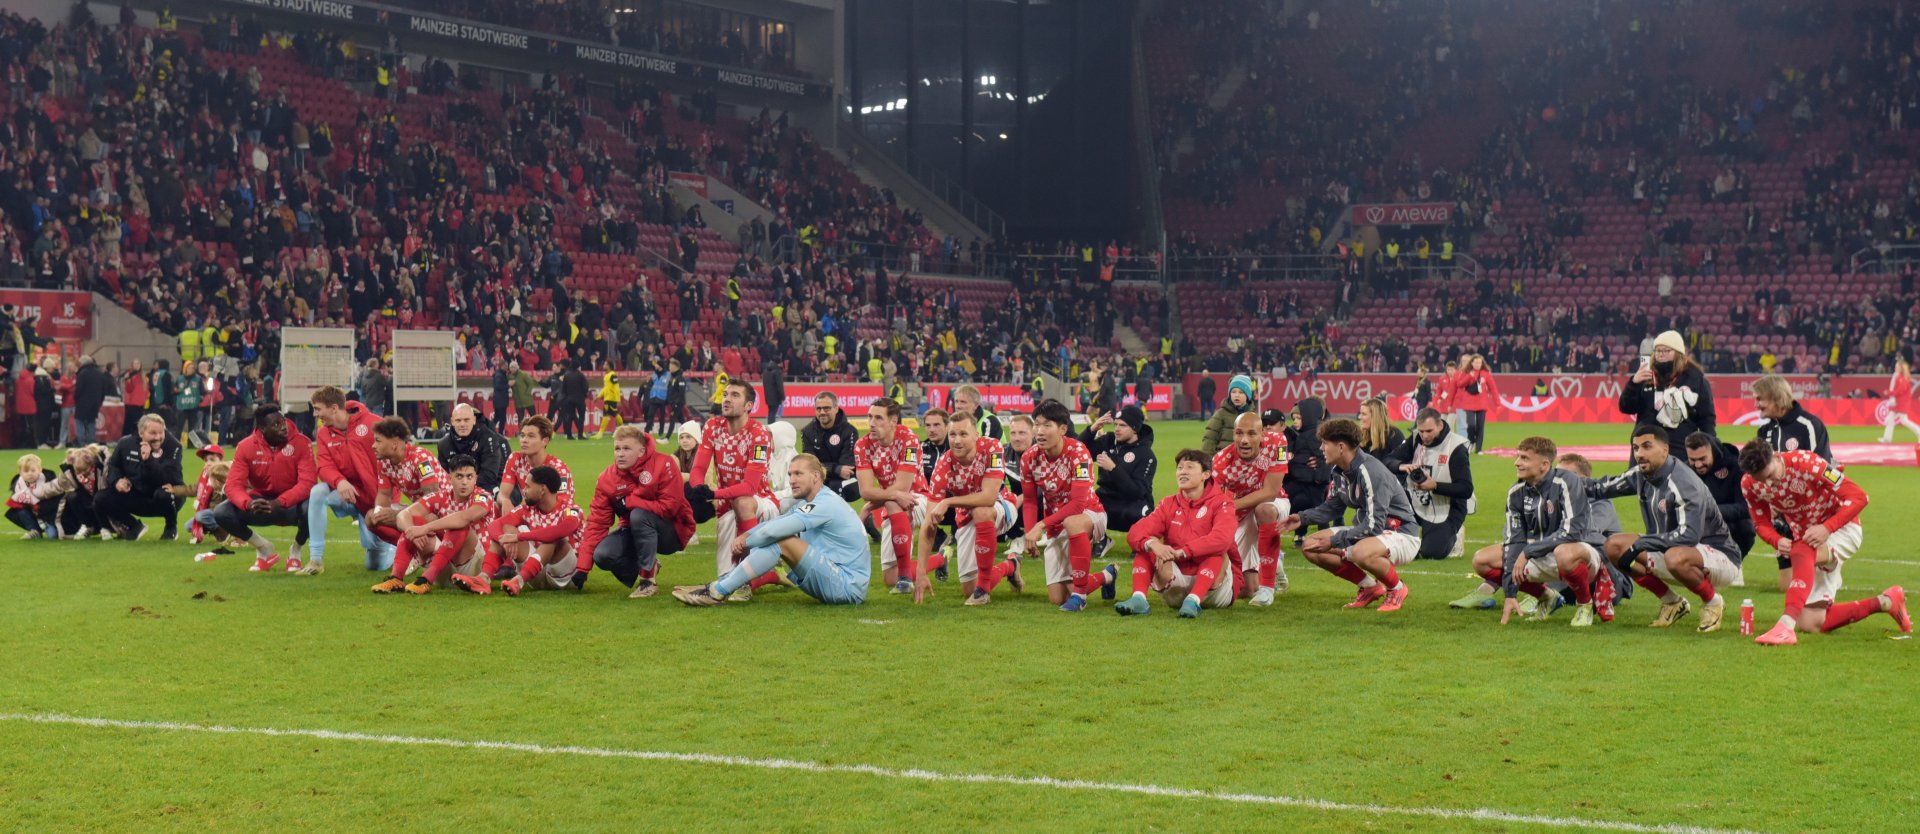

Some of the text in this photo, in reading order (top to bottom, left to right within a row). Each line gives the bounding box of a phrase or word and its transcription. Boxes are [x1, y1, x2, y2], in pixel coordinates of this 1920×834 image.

[273, 0, 354, 19] STADTWERKE
[411, 16, 528, 49] MAINZER STADTWERKE
[576, 45, 677, 74] MAINZER STADTWERKE
[718, 70, 806, 95] MAINZER STADTWERKE
[848, 396, 857, 407] IST
[858, 396, 879, 407] MAIN
